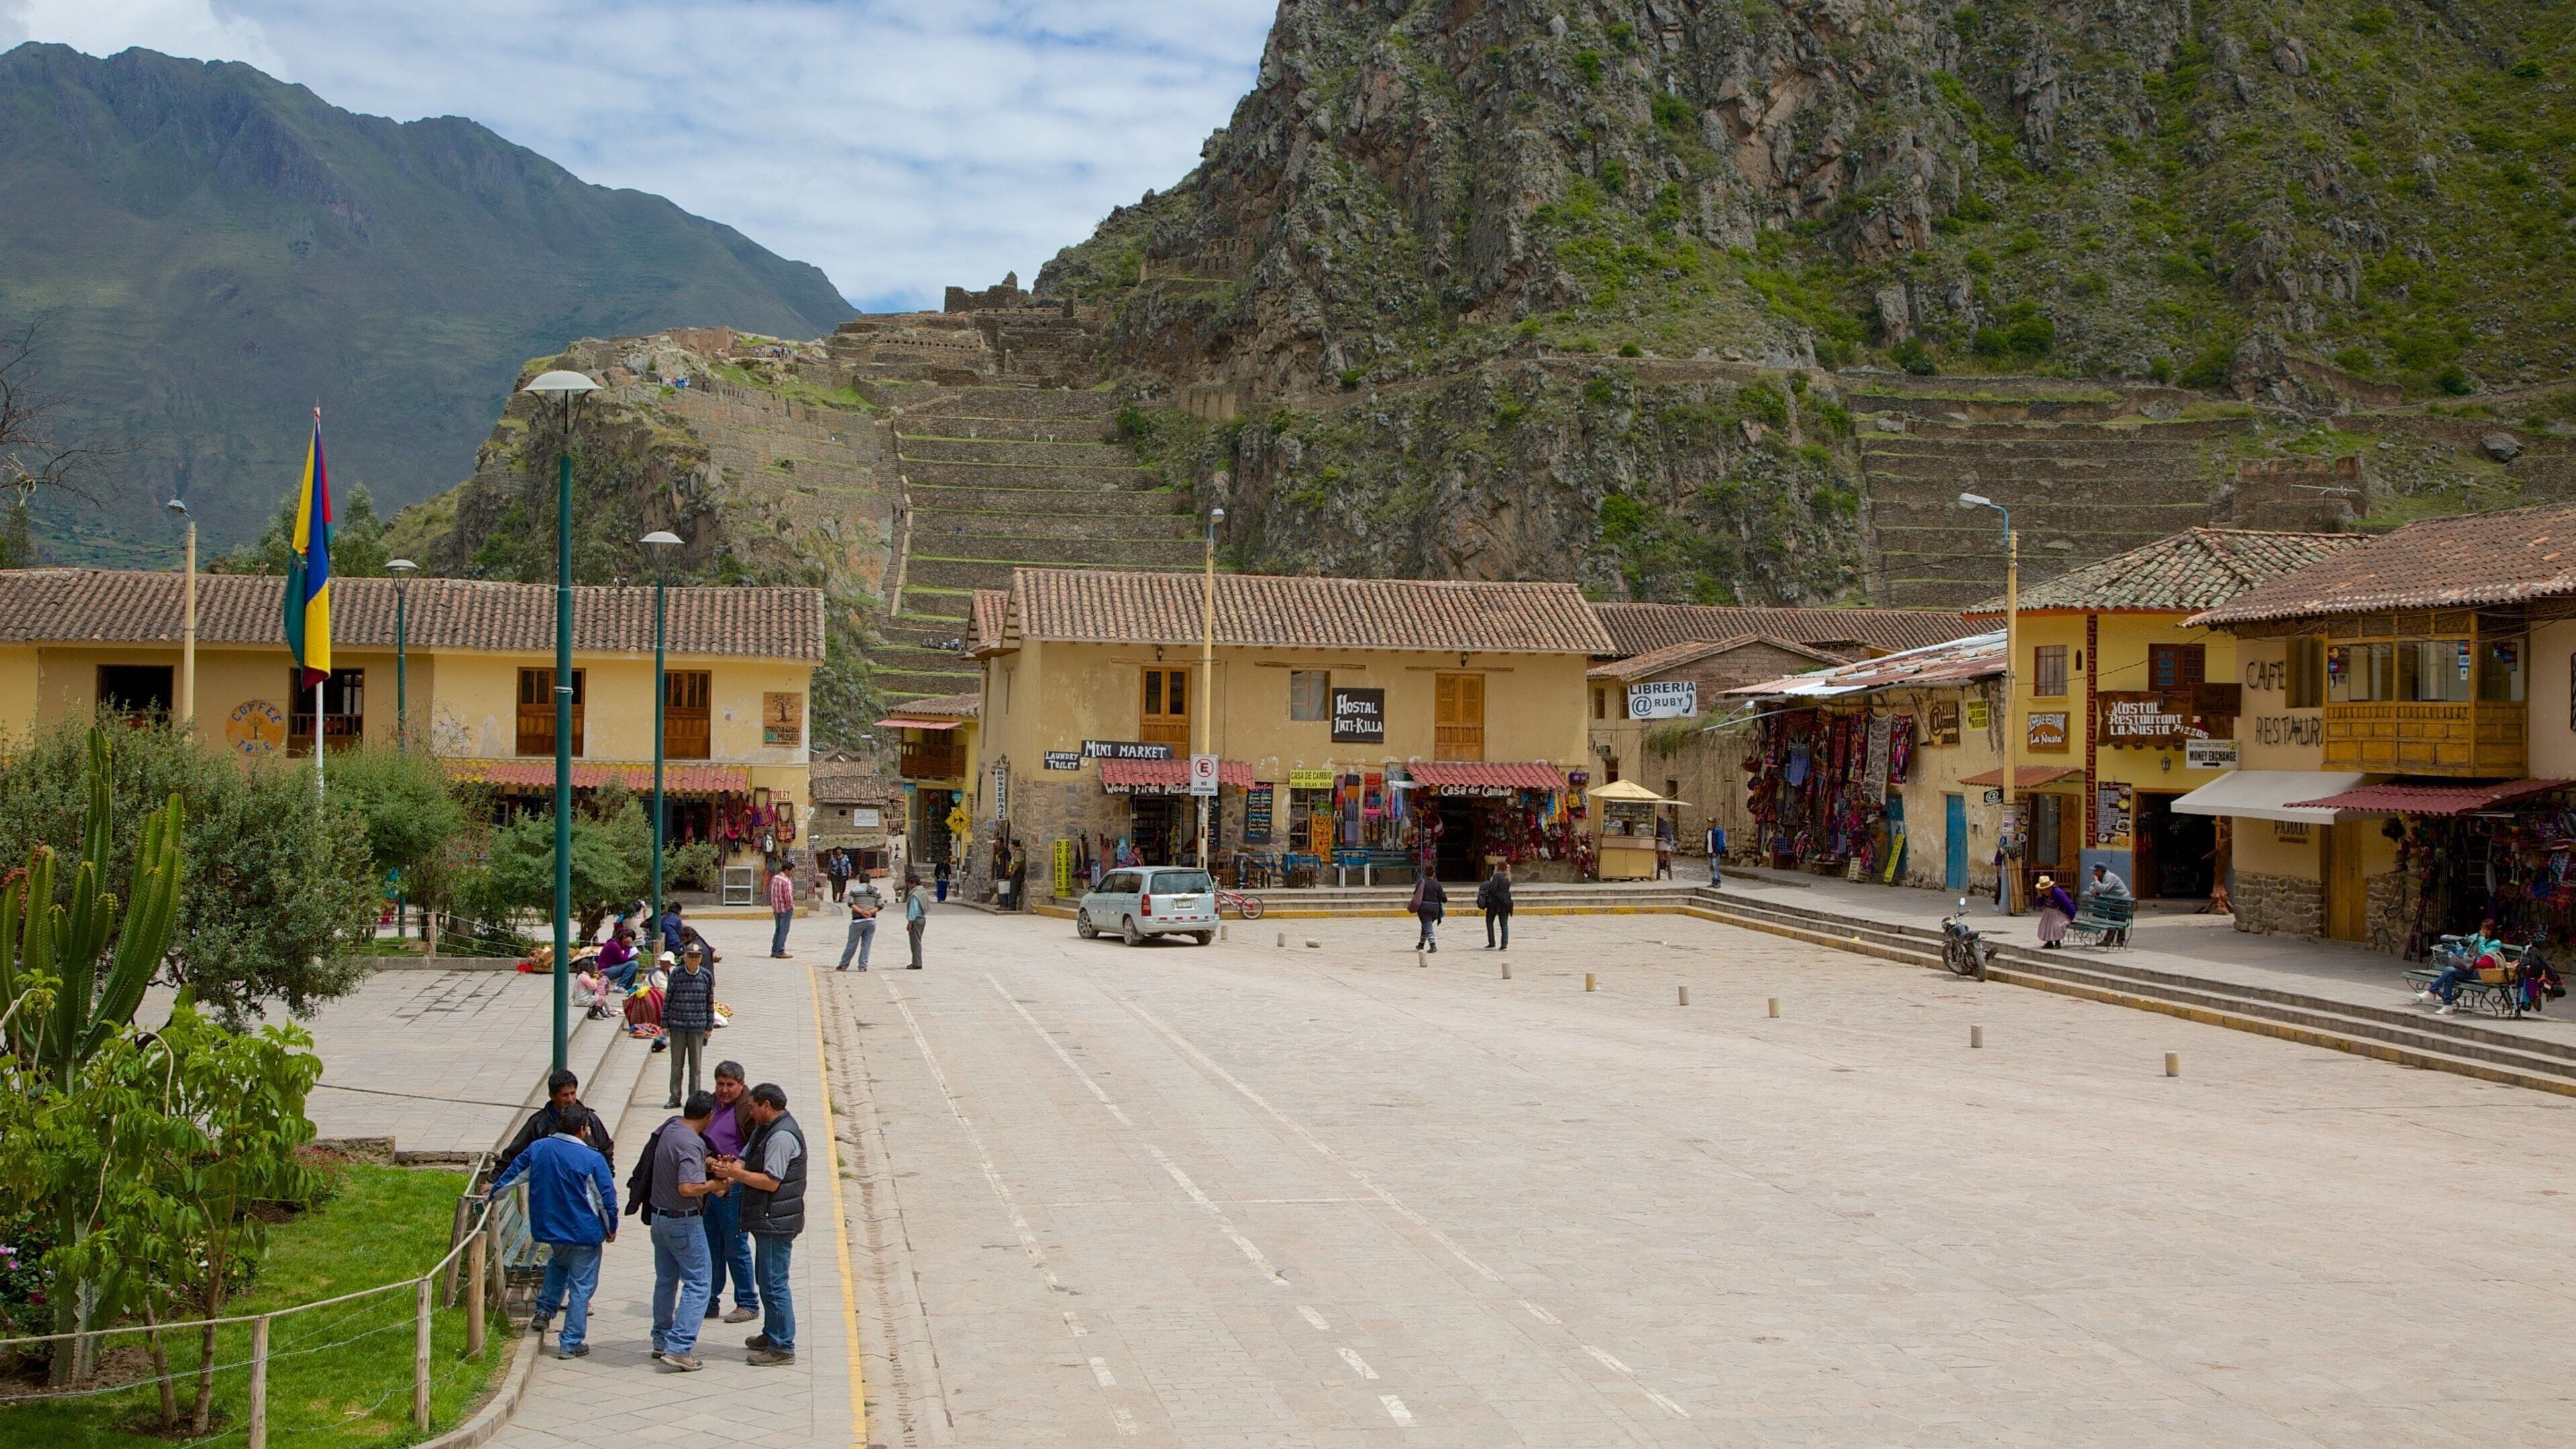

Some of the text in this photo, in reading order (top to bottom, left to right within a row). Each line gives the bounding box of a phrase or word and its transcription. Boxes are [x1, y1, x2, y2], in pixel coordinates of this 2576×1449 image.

[2246, 661, 2286, 690] CAFE
[1629, 682, 1695, 695] LIBRERIA
[1654, 697, 1683, 706] RUBY
[231, 700, 281, 723] COFFEE
[777, 733, 799, 741] MUSEO
[1118, 745, 1167, 759] MARKET
[2190, 751, 2237, 762] MONEY EXCHANGE
[1200, 762, 1209, 773] E
[1291, 771, 1332, 780] CASA DE CAMBIO
[1104, 783, 1130, 794] Wood
[1440, 784, 1466, 796] Casa
[1468, 784, 1480, 794] de
[1481, 785, 1513, 797] Cambio
[770, 790, 790, 800] TOILET
[997, 771, 1005, 820] HOSPEDAJE
